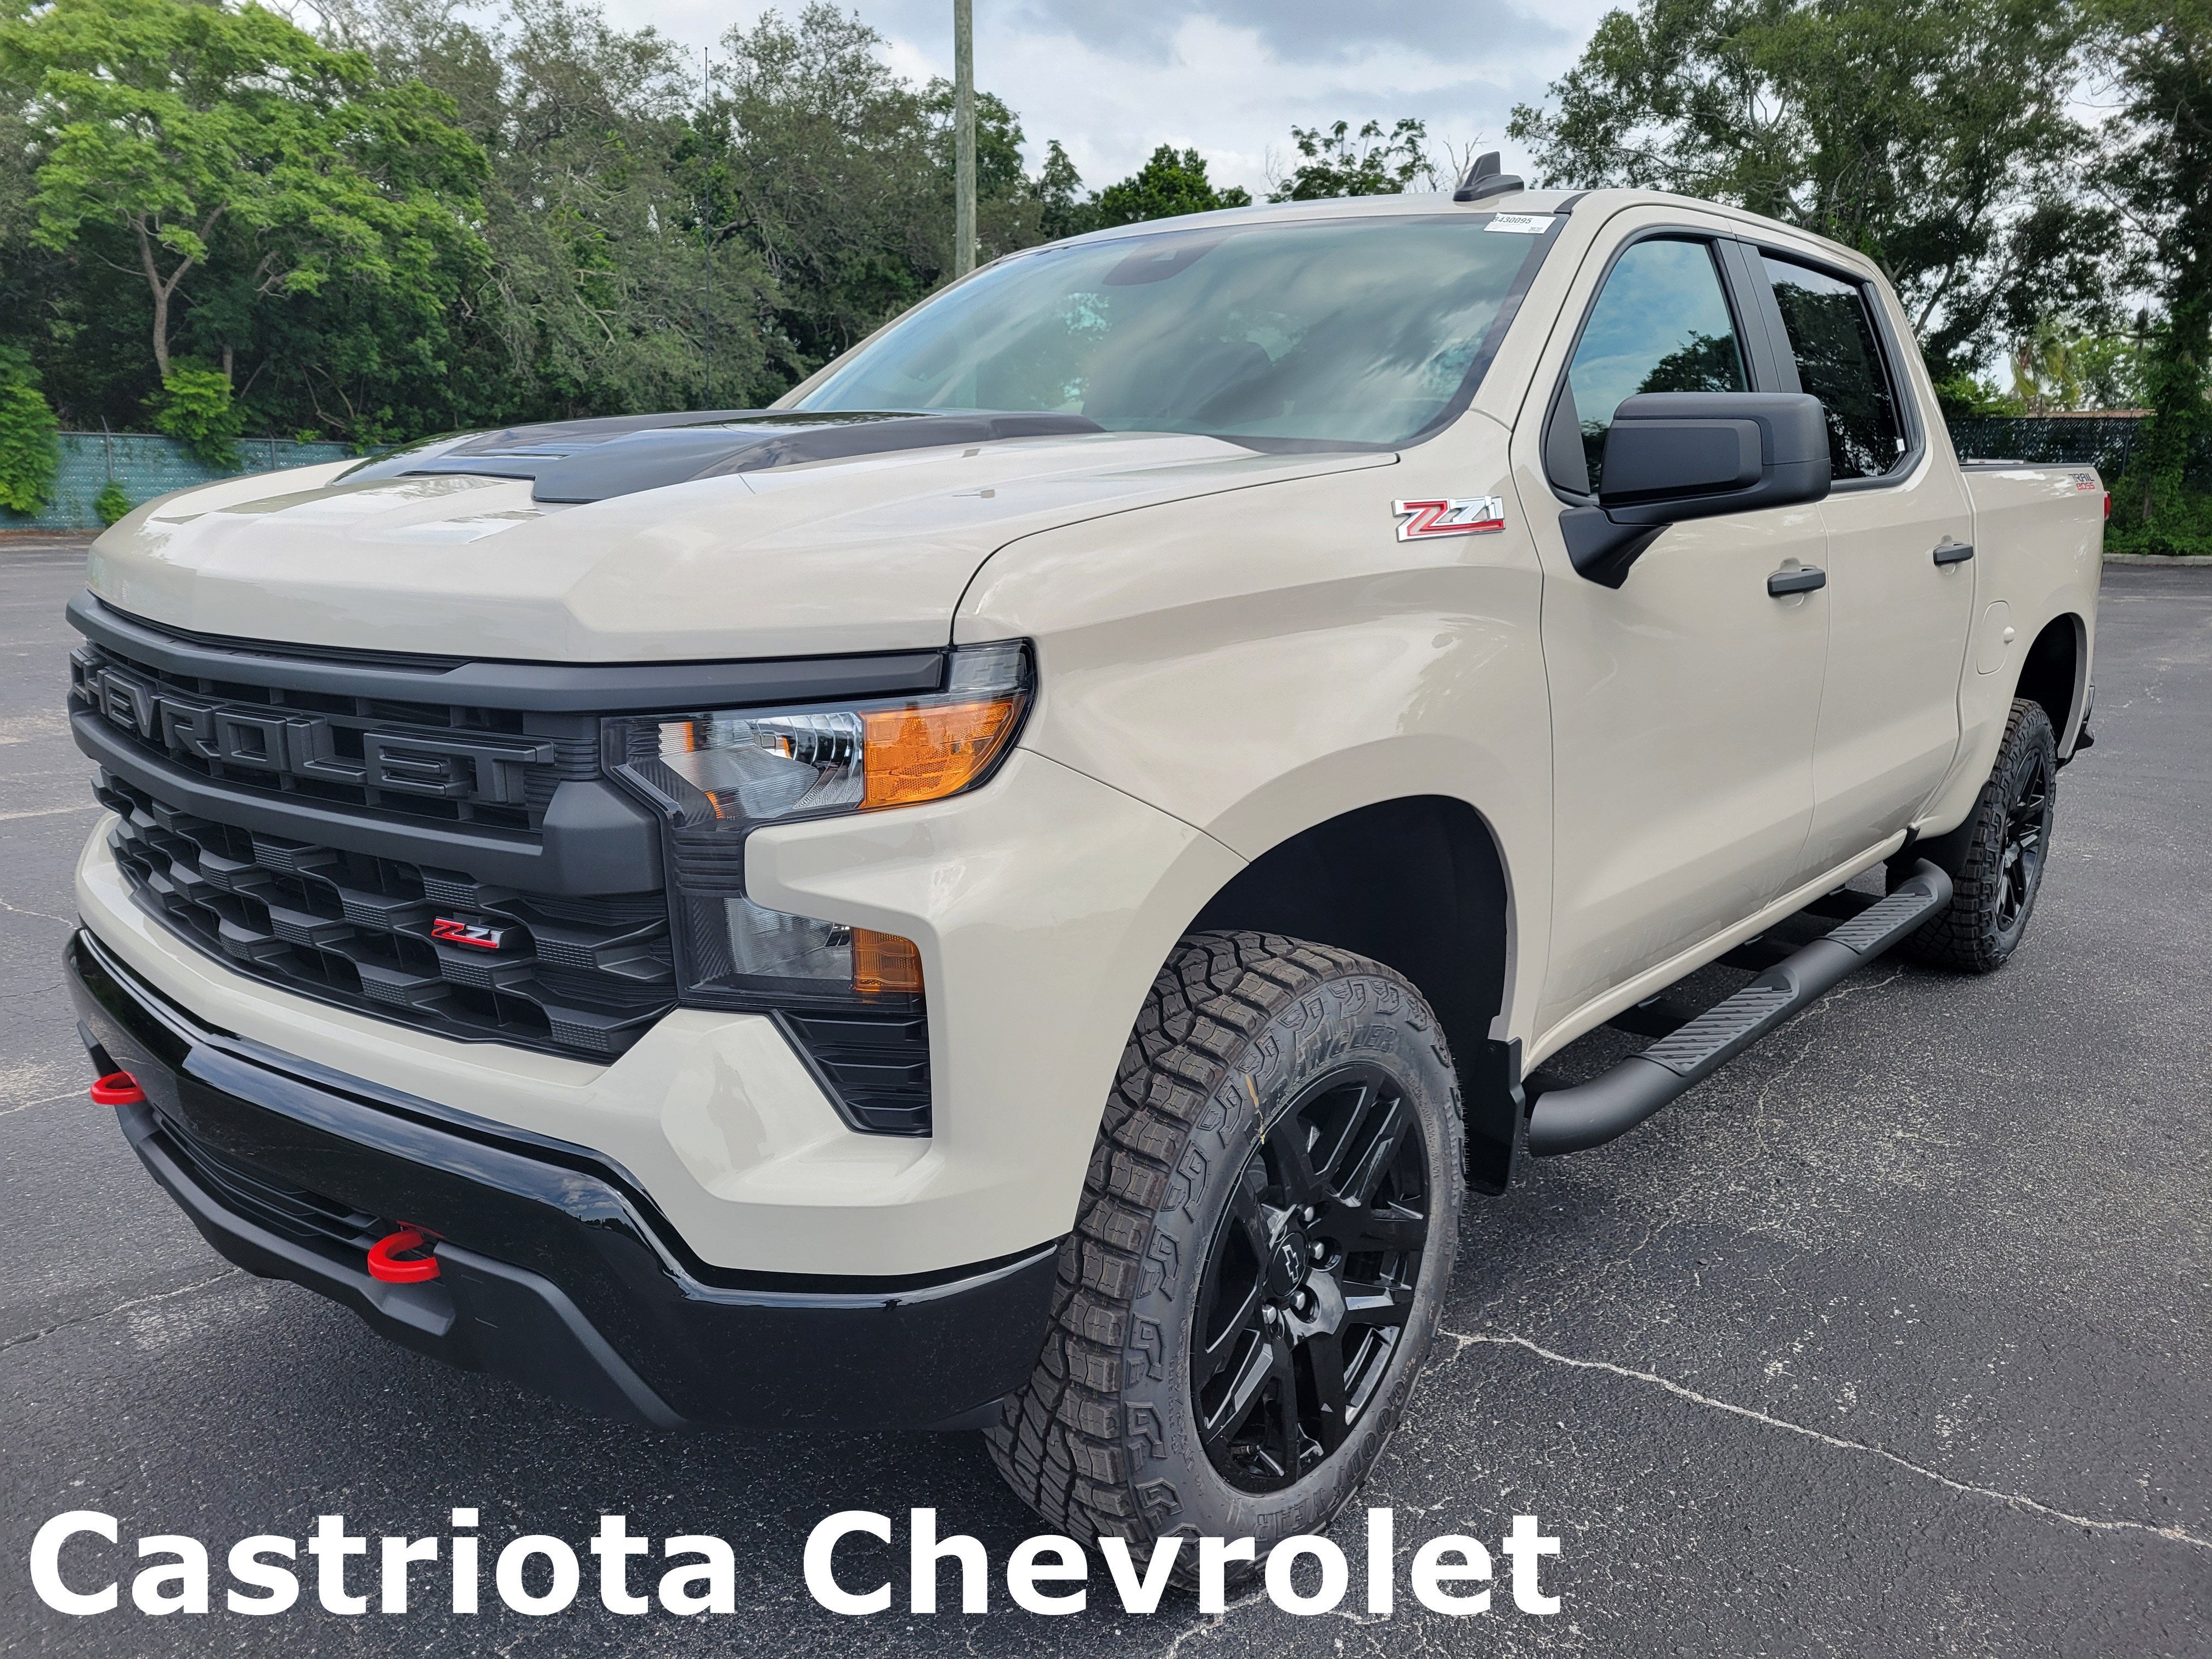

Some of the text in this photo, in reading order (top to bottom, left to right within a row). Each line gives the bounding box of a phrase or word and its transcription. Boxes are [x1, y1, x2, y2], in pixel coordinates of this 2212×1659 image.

[2068, 473, 2095, 482] TRAIL
[1391, 495, 1506, 543] Z71
[431, 917, 504, 949] Z71
